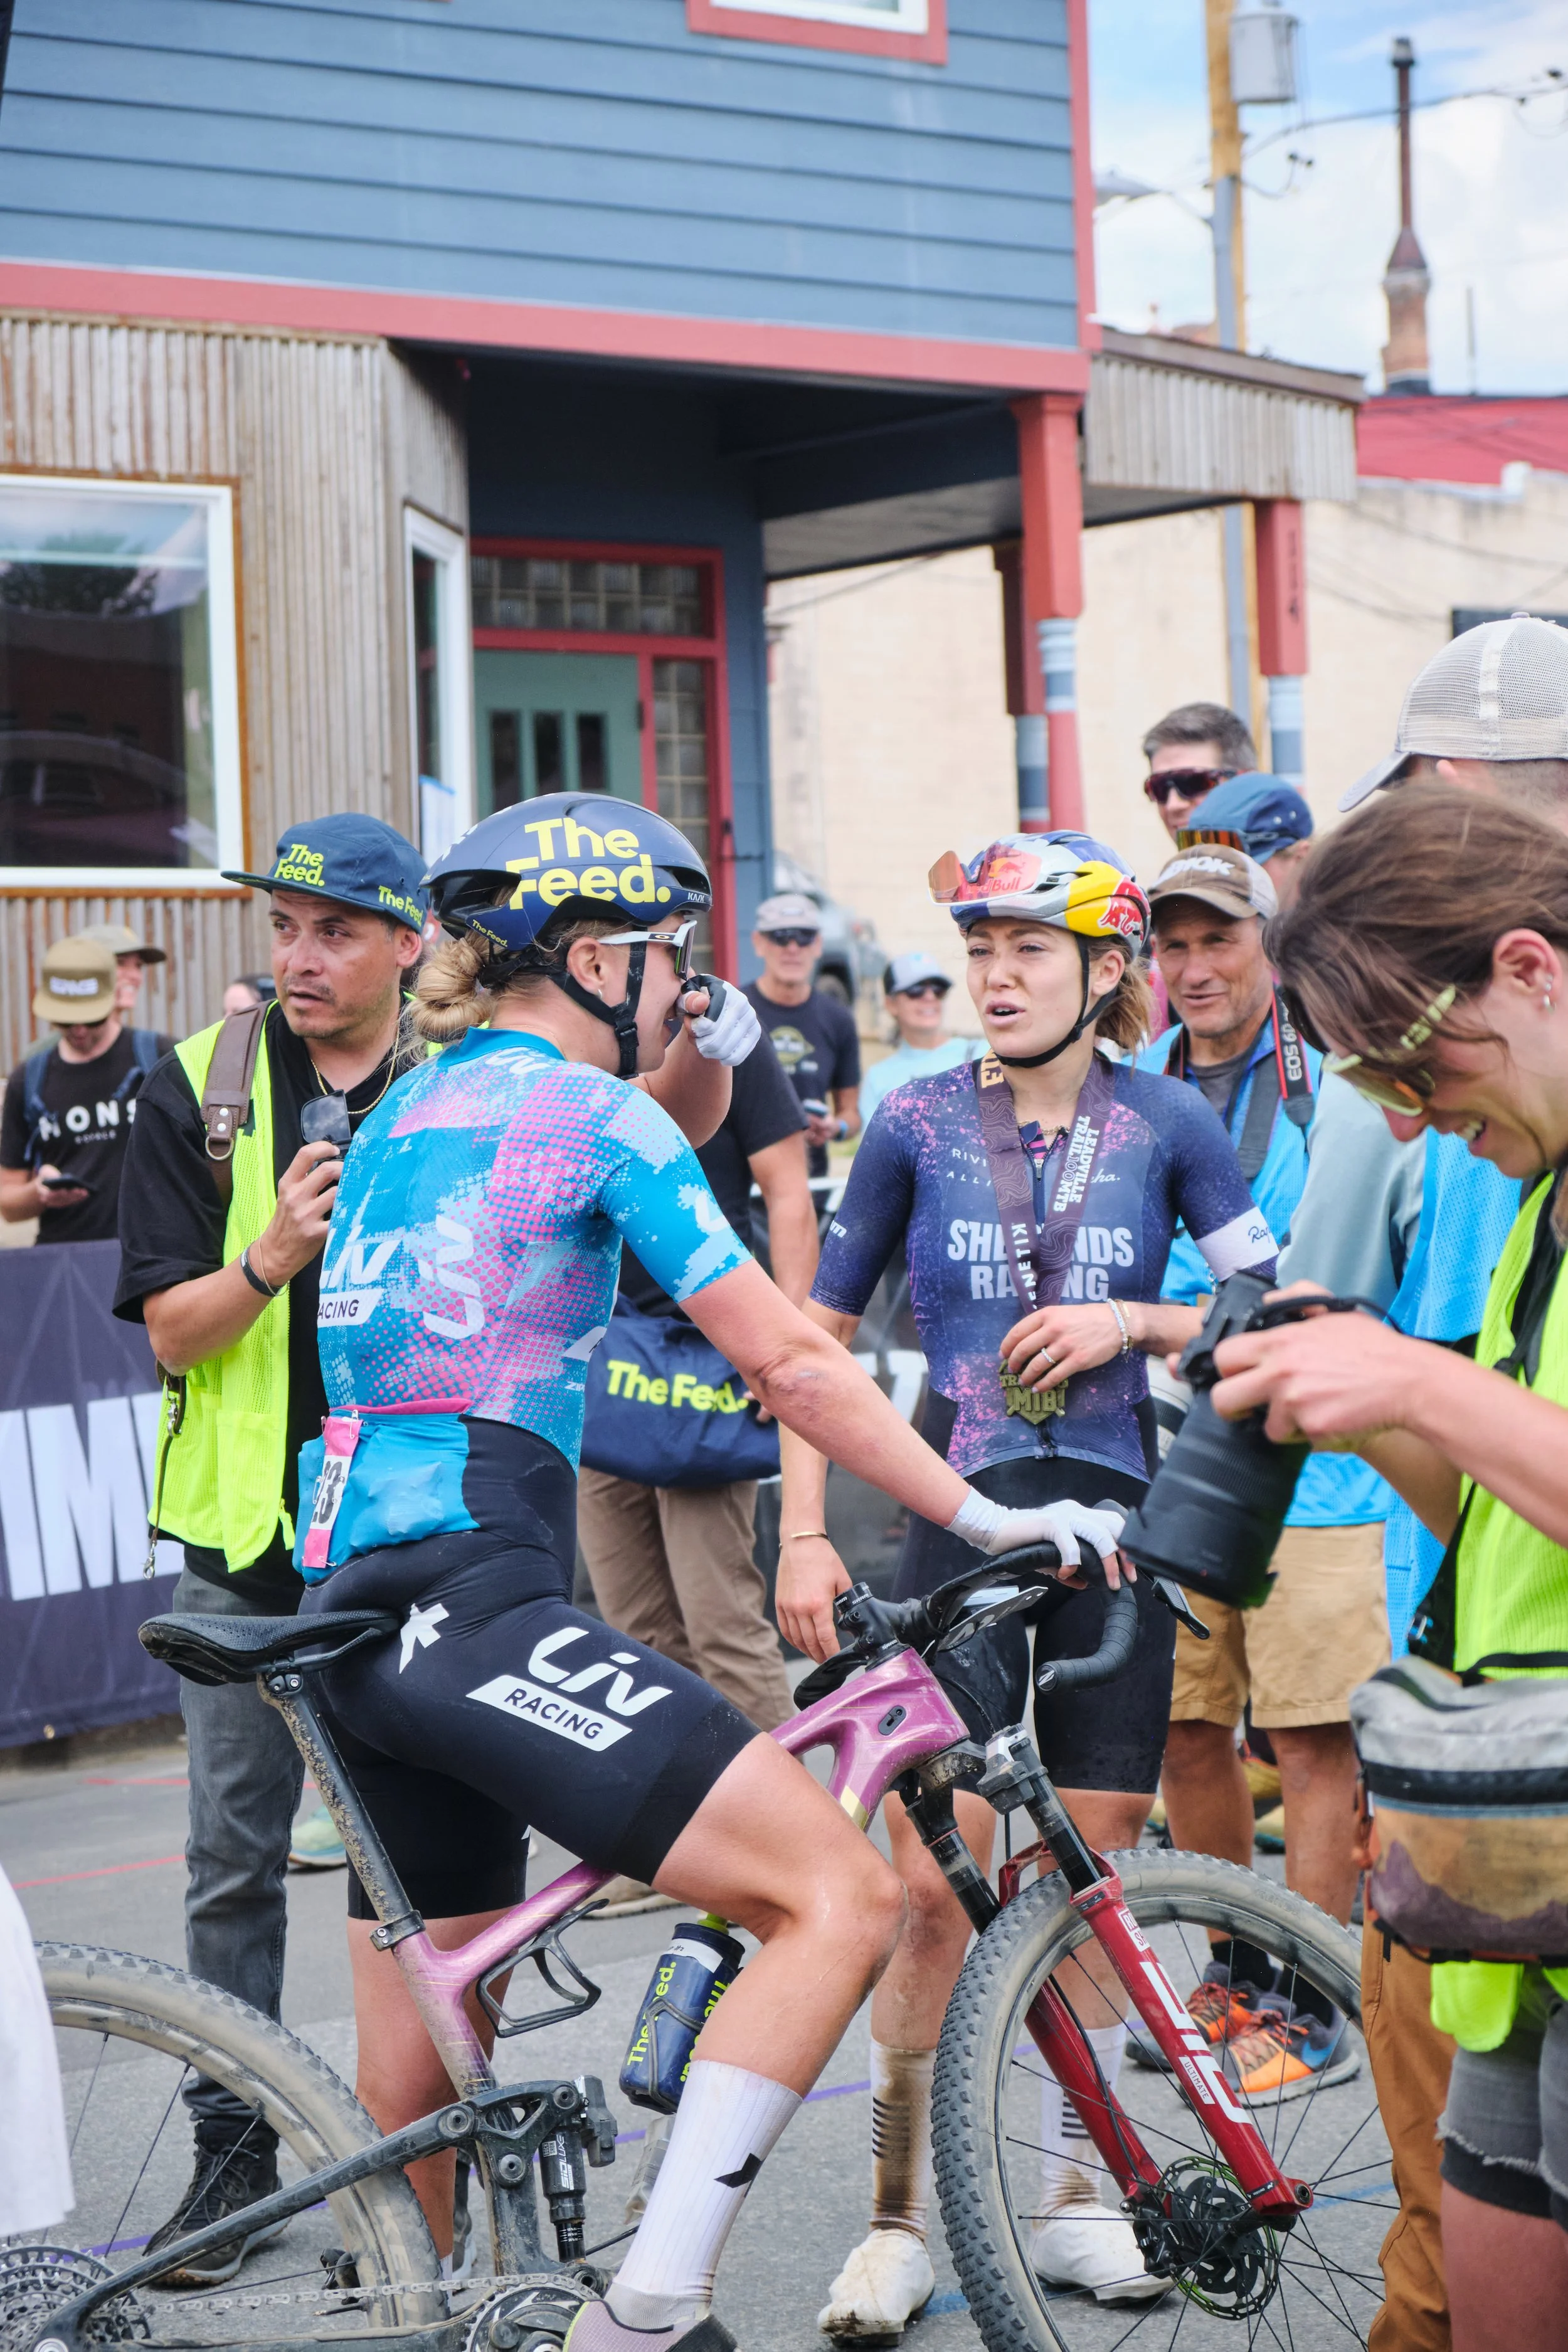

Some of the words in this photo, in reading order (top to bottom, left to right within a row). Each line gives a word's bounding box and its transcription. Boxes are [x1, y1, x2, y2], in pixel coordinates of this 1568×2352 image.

[285, 844, 324, 867] The
[524, 817, 639, 861] The
[274, 859, 326, 887] Feed.
[506, 854, 671, 910] Feed.
[378, 885, 405, 911] The
[472, 919, 487, 935] The
[486, 928, 508, 948] Feed.
[1283, 1044, 1303, 1081] EOS
[953, 1148, 987, 1167] RIVI
[1068, 1128, 1100, 1204] LEADVILLE
[970, 1264, 1110, 1303] RANG
[317, 1299, 359, 1320] ACING
[607, 1359, 669, 1405] The
[528, 1627, 673, 1717] Liv
[504, 1688, 603, 1740] RACING
[1184, 2062, 1209, 2099] ULTIMATE
